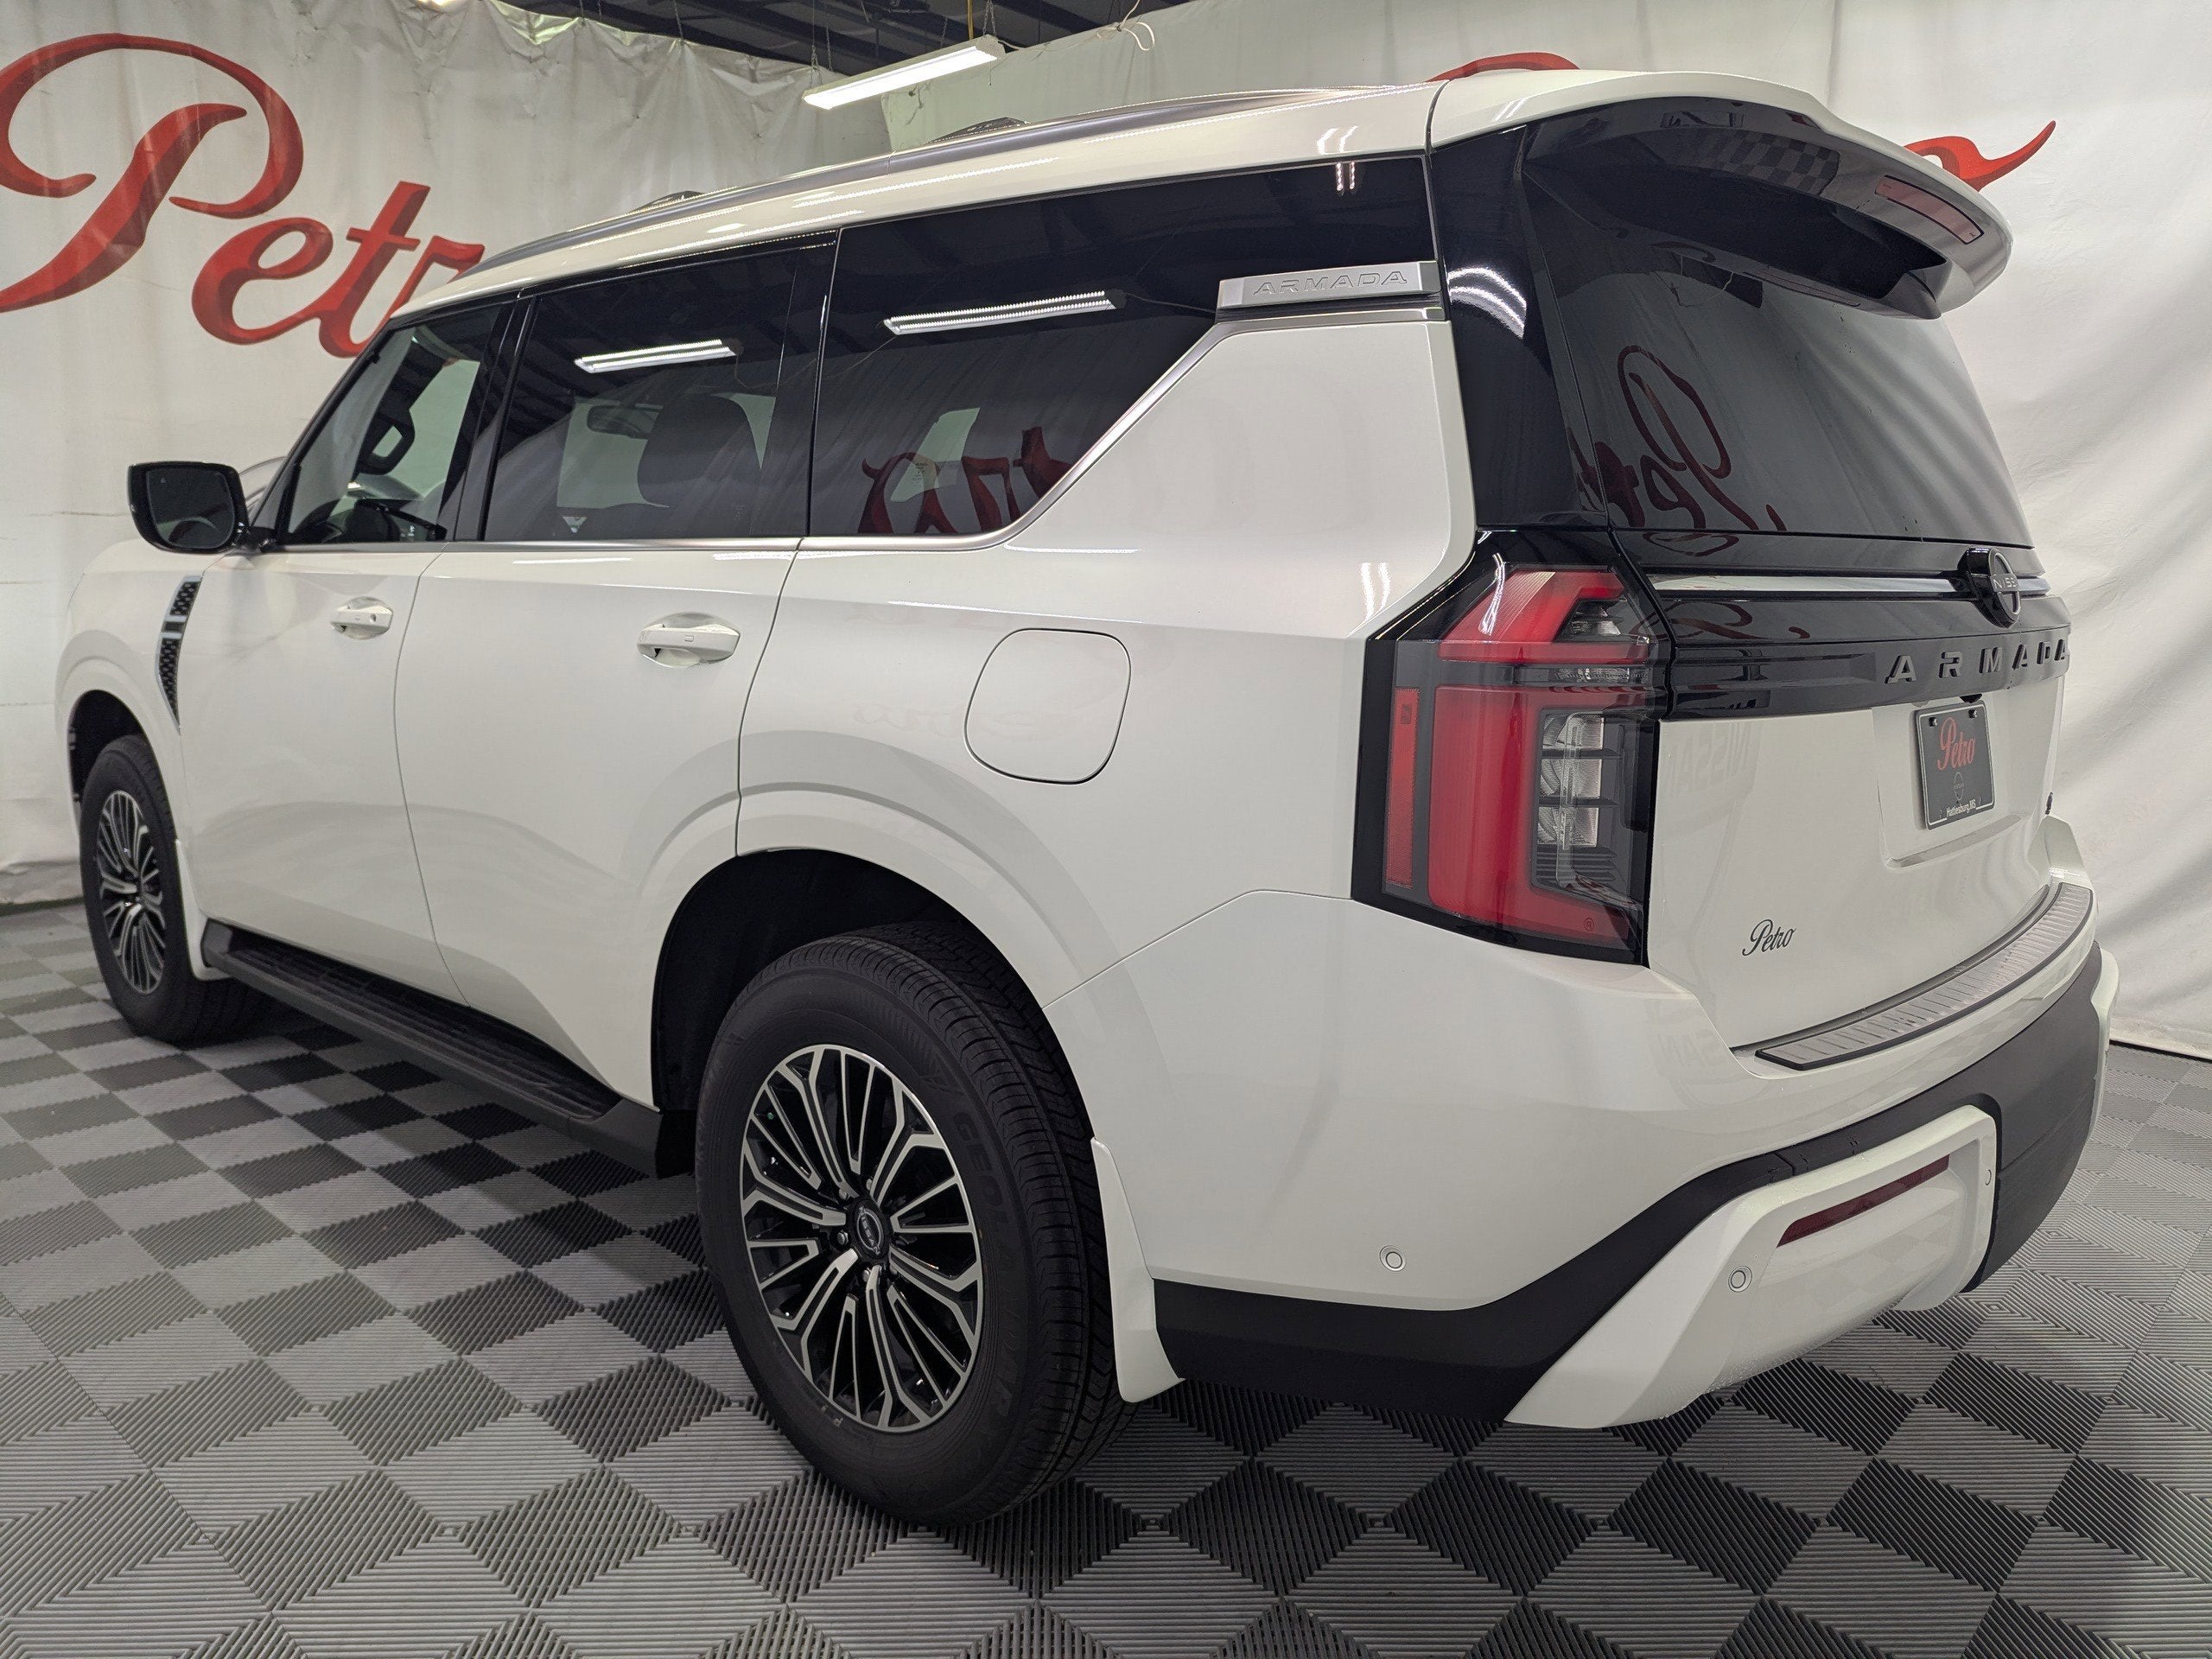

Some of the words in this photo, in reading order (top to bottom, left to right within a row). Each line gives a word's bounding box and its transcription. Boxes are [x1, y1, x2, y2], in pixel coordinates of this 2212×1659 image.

[0, 32, 486, 359] Petr
[1252, 270, 1408, 296] ARMADA
[1884, 638, 2066, 684] ARMADA
[1937, 716, 1976, 771] Petro
[1742, 918, 1797, 957] Petro
